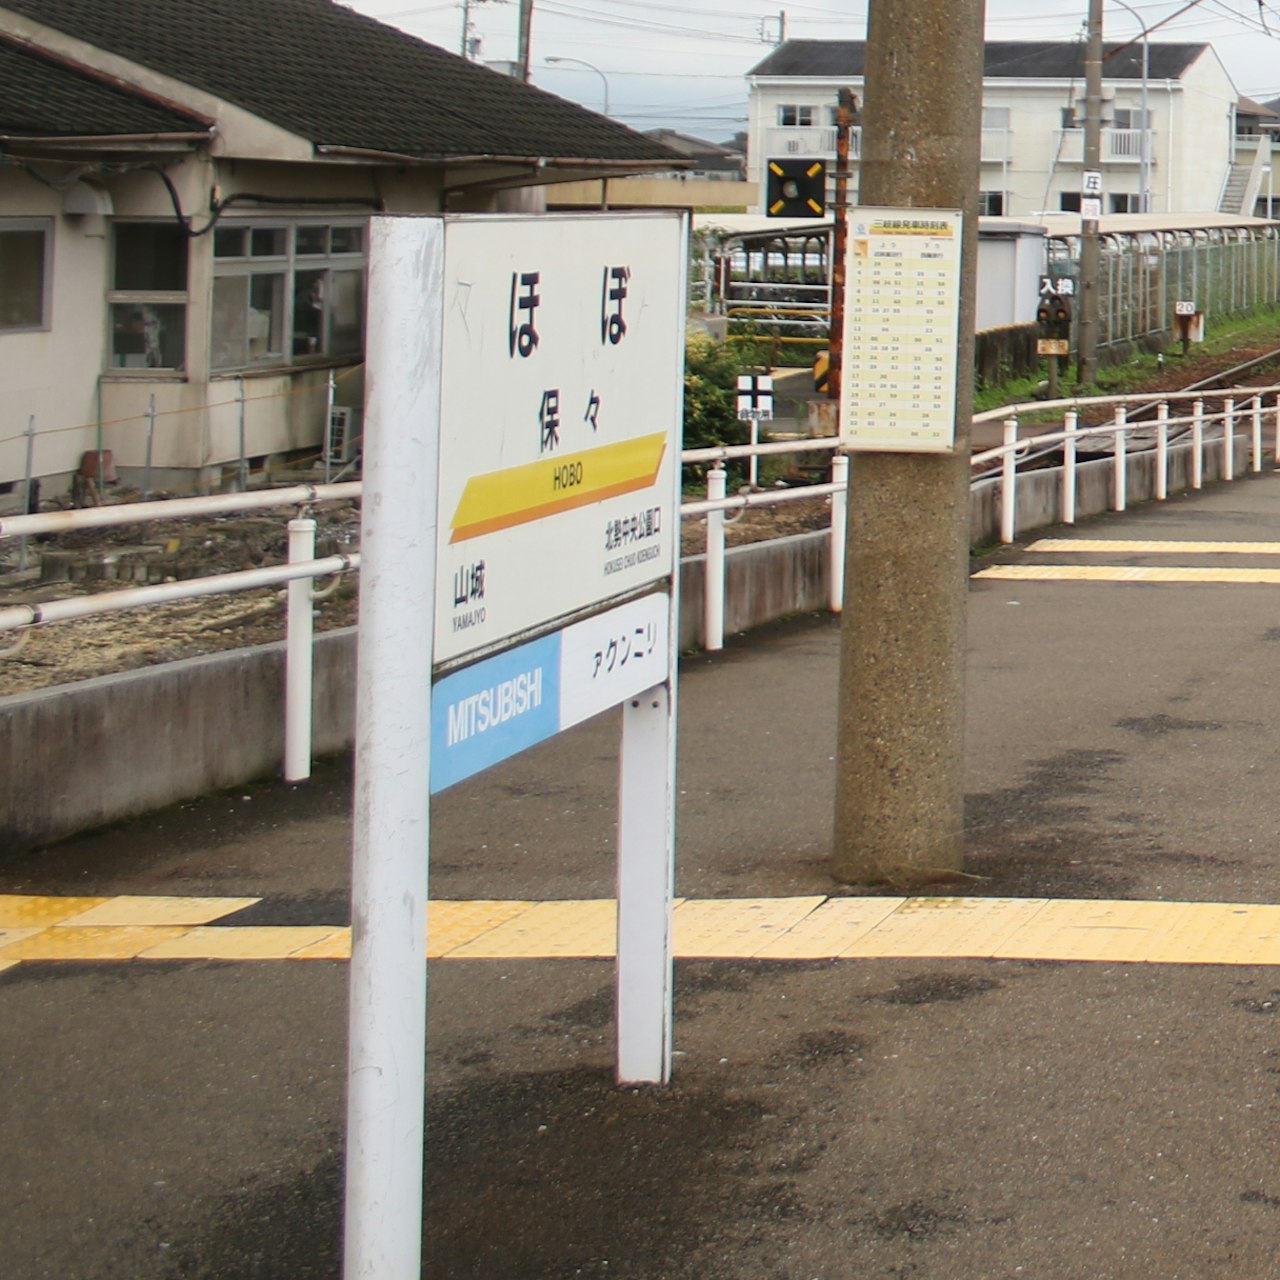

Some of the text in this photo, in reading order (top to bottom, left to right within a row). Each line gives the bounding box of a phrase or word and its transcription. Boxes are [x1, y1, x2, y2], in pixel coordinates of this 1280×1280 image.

[1040, 278, 1074, 295] 入換
[508, 266, 632, 359] ほぼ
[1177, 303, 1194, 313] 20
[538, 389, 601, 453] 保々
[553, 461, 584, 491] HOBO
[454, 560, 486, 608] 山城
[452, 607, 487, 633] YAMAJYO
[447, 667, 543, 747] MITSUBISHI
